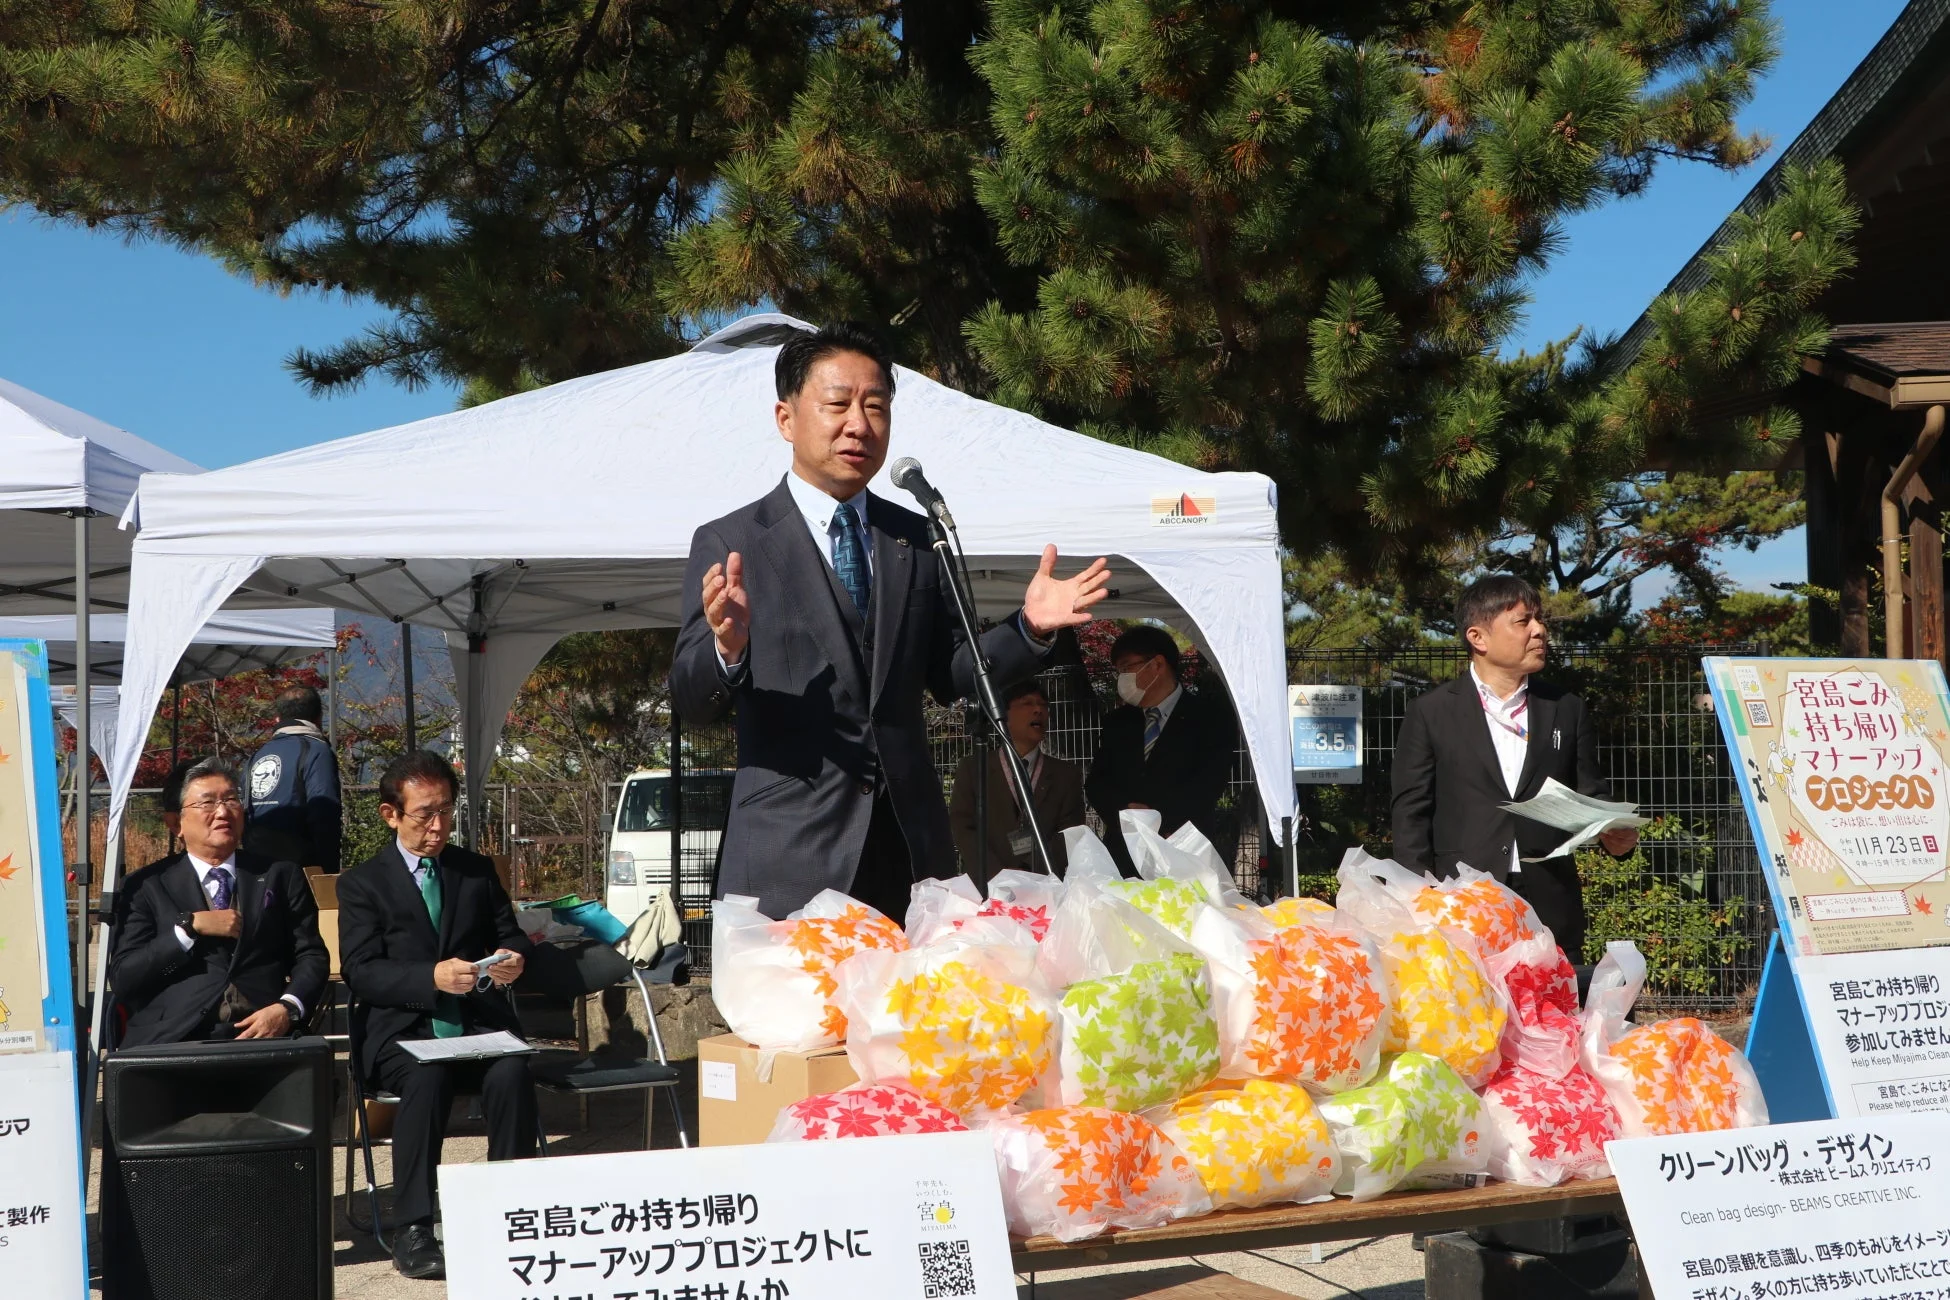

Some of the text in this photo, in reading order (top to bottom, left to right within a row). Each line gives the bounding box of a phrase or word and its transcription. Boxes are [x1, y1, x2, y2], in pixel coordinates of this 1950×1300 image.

[1159, 517, 1208, 525] ABCCANOPY
[1793, 678, 1890, 708] 宮島ごみ
[1804, 711, 1898, 742] 持ち帰り
[1800, 744, 1922, 771] マナーアップ
[1808, 778, 1930, 806] プロジェクト
[1830, 975, 1940, 1001] 宮島ごみ持ち帰り
[1837, 1000, 1950, 1027] マナーアッププロジ
[1851, 1057, 1870, 1068] Help
[1871, 1055, 1892, 1066] Keep
[1892, 1052, 1927, 1064] Miyajima
[1869, 1094, 1949, 1111] Please help reduce all
[1878, 1079, 1950, 1099] 宮島で、ごみにな
[1778, 1167, 1828, 1187] 株式会社
[1828, 1162, 1869, 1182] ビームス
[1870, 1155, 1932, 1176] クリエイティブ
[0, 1205, 50, 1228] 製作
[504, 1193, 759, 1242] 宮島ごみ持ち帰り
[1680, 1210, 1715, 1226] Clean
[1717, 1206, 1742, 1223] bag
[1790, 1194, 1832, 1213] BEAMS
[1833, 1188, 1892, 1209] CREATIVE
[1895, 1185, 1921, 1201] INC.
[508, 1228, 872, 1287] マナーアッププロジェクトに
[1682, 1229, 1950, 1279] 宮島の景観を意識し、四季のもみじをイメージ
